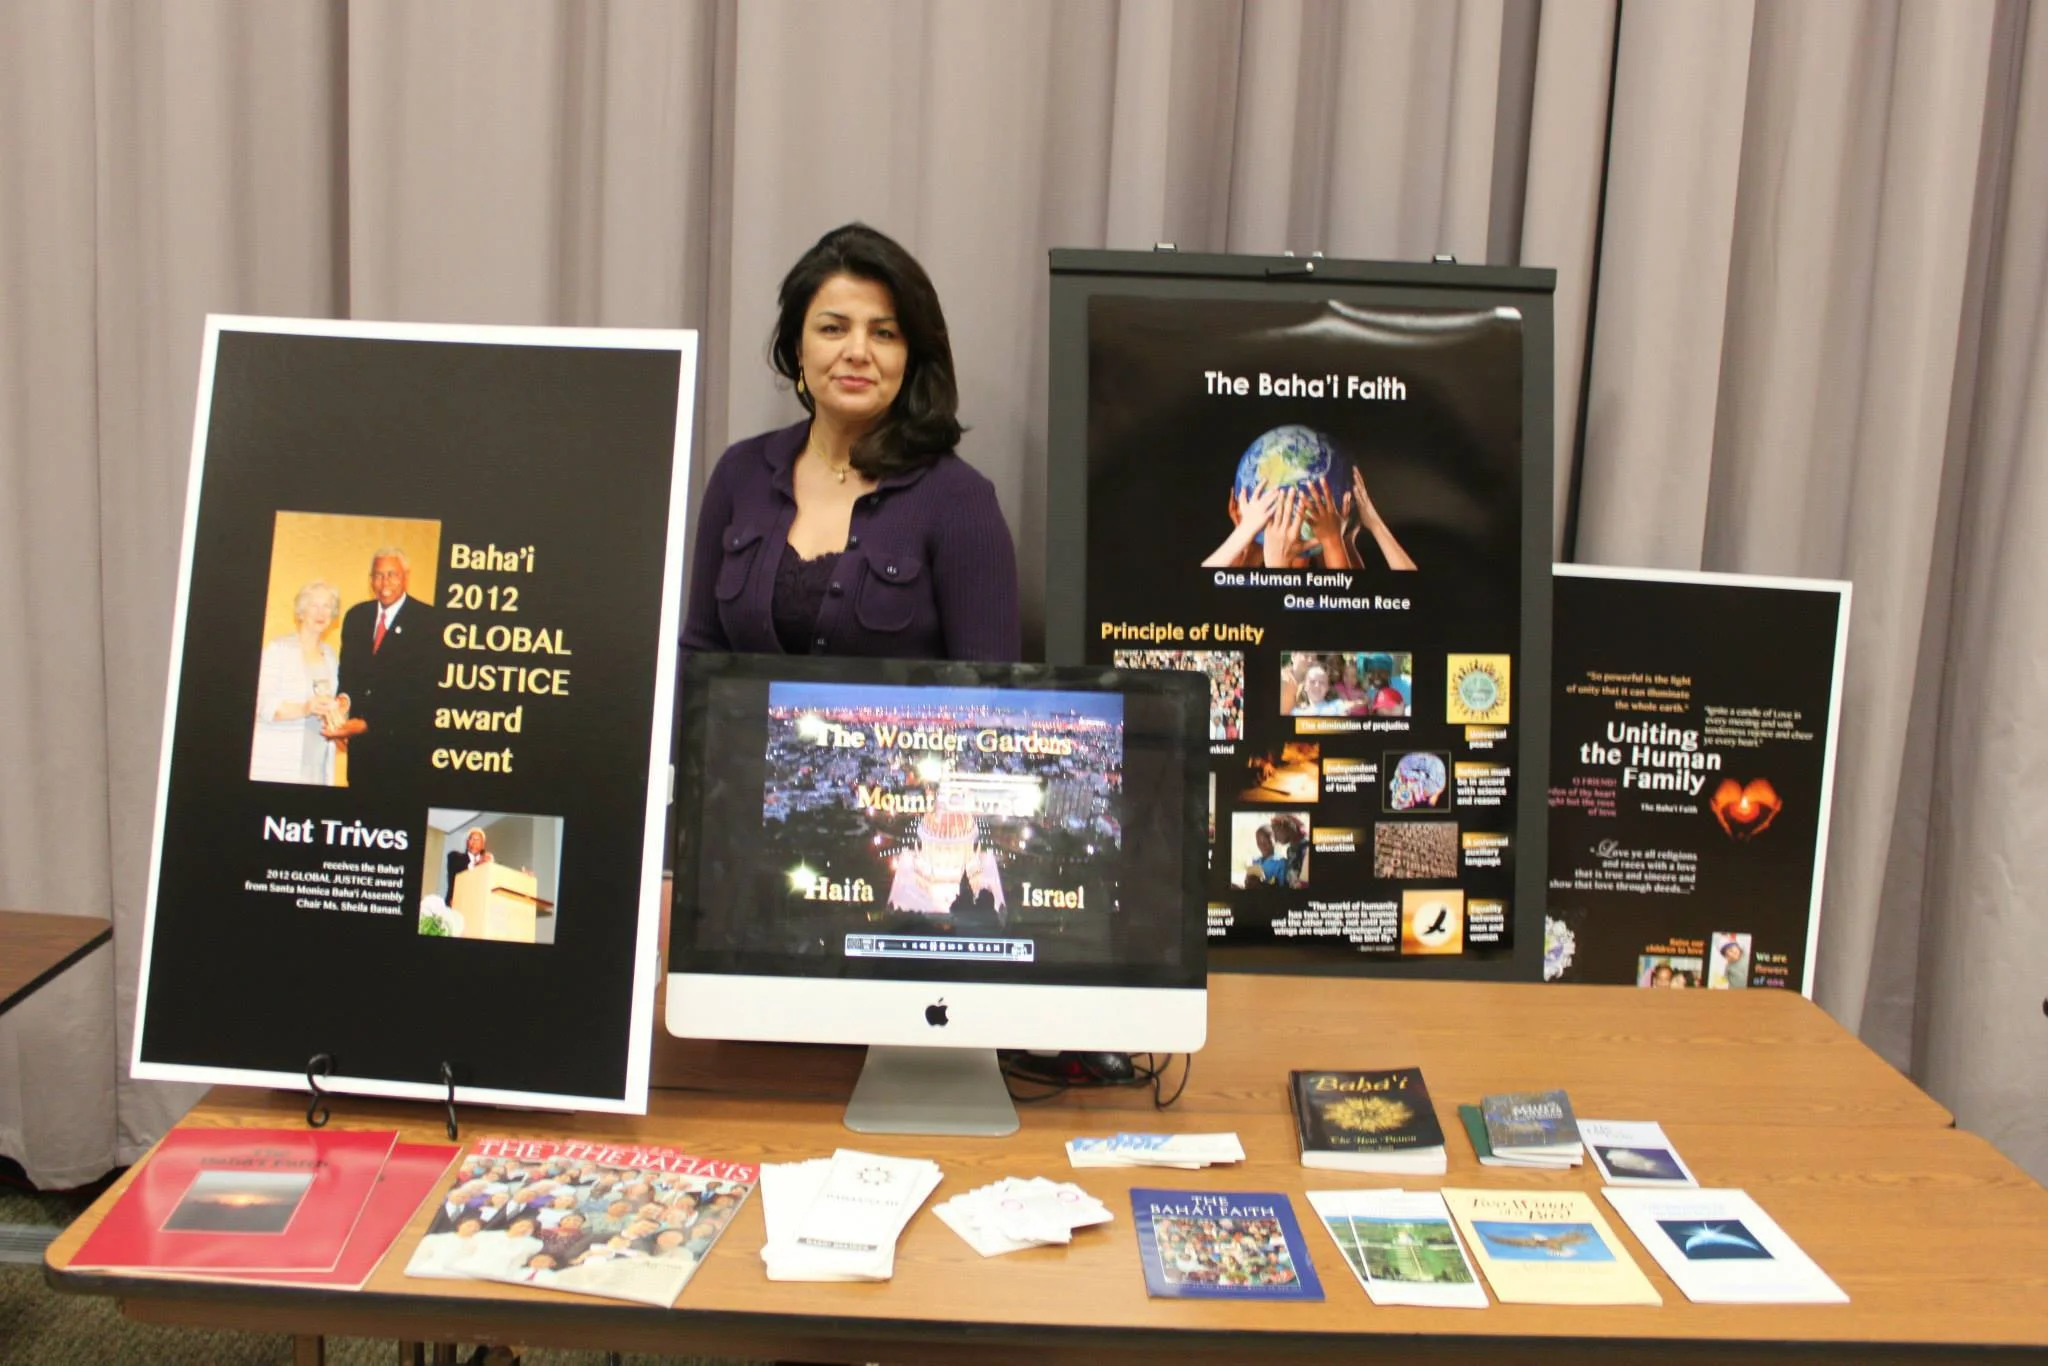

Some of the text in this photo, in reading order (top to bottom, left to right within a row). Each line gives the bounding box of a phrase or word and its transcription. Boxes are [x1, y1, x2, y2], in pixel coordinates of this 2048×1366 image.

[1204, 372, 1406, 400] The Baha'i Faith
[450, 544, 535, 573] Baha'i
[1214, 571, 1352, 590] One Human Family
[446, 584, 518, 612] 2012
[1284, 595, 1410, 610] One Human Race
[443, 623, 572, 656] GLOBAL
[1101, 622, 1264, 645] Principle of Unity
[438, 663, 570, 696] JUSTICE
[435, 706, 523, 734] award
[1317, 722, 1361, 730] elimination
[1363, 721, 1371, 730] of
[1373, 721, 1410, 732] prejudice
[816, 724, 1071, 755] The Wonder Gardens
[1607, 721, 1699, 752] Uniting
[432, 746, 513, 774] event
[1580, 741, 1720, 770] the Human
[1327, 764, 1377, 774] Independent
[1326, 774, 1375, 784] investigation
[1326, 783, 1356, 792] of truth
[1622, 767, 1706, 796] Family
[859, 787, 934, 813] Mount
[1457, 787, 1506, 796] with science
[1457, 797, 1472, 805] and
[1641, 803, 1654, 811] The
[1679, 804, 1698, 814] Faith
[264, 815, 408, 850] Nat Trives
[1315, 843, 1355, 852] education
[1632, 851, 1643, 860] ye
[1644, 849, 1655, 859] all
[1657, 850, 1697, 861] religions
[323, 861, 359, 872] receives
[361, 862, 375, 872] the
[1602, 860, 1619, 868] and
[1621, 861, 1645, 869] races
[1647, 861, 1667, 870] with
[1677, 863, 1696, 872] love
[267, 869, 403, 888] 2012 GLOBAL JUSTICE award
[1575, 868, 1695, 883] that is true and sincere and
[245, 880, 268, 891] from
[269, 882, 294, 893] Santa
[297, 884, 329, 895] Monica
[361, 891, 404, 902] Assembly
[804, 878, 874, 903] Haifa
[1574, 880, 1592, 889] that
[1595, 881, 1614, 890] love
[1616, 882, 1651, 893] through
[296, 898, 321, 908] Chair
[341, 901, 367, 912] Sheila
[1021, 882, 1085, 910] Israel
[1756, 952, 1787, 962] We are
[1316, 1074, 1408, 1092] Baha'i
[479, 1143, 542, 1157] THE
[565, 1142, 622, 1164] THE
[1191, 1196, 1228, 1207] THE
[1221, 1206, 1274, 1216] FAITH
